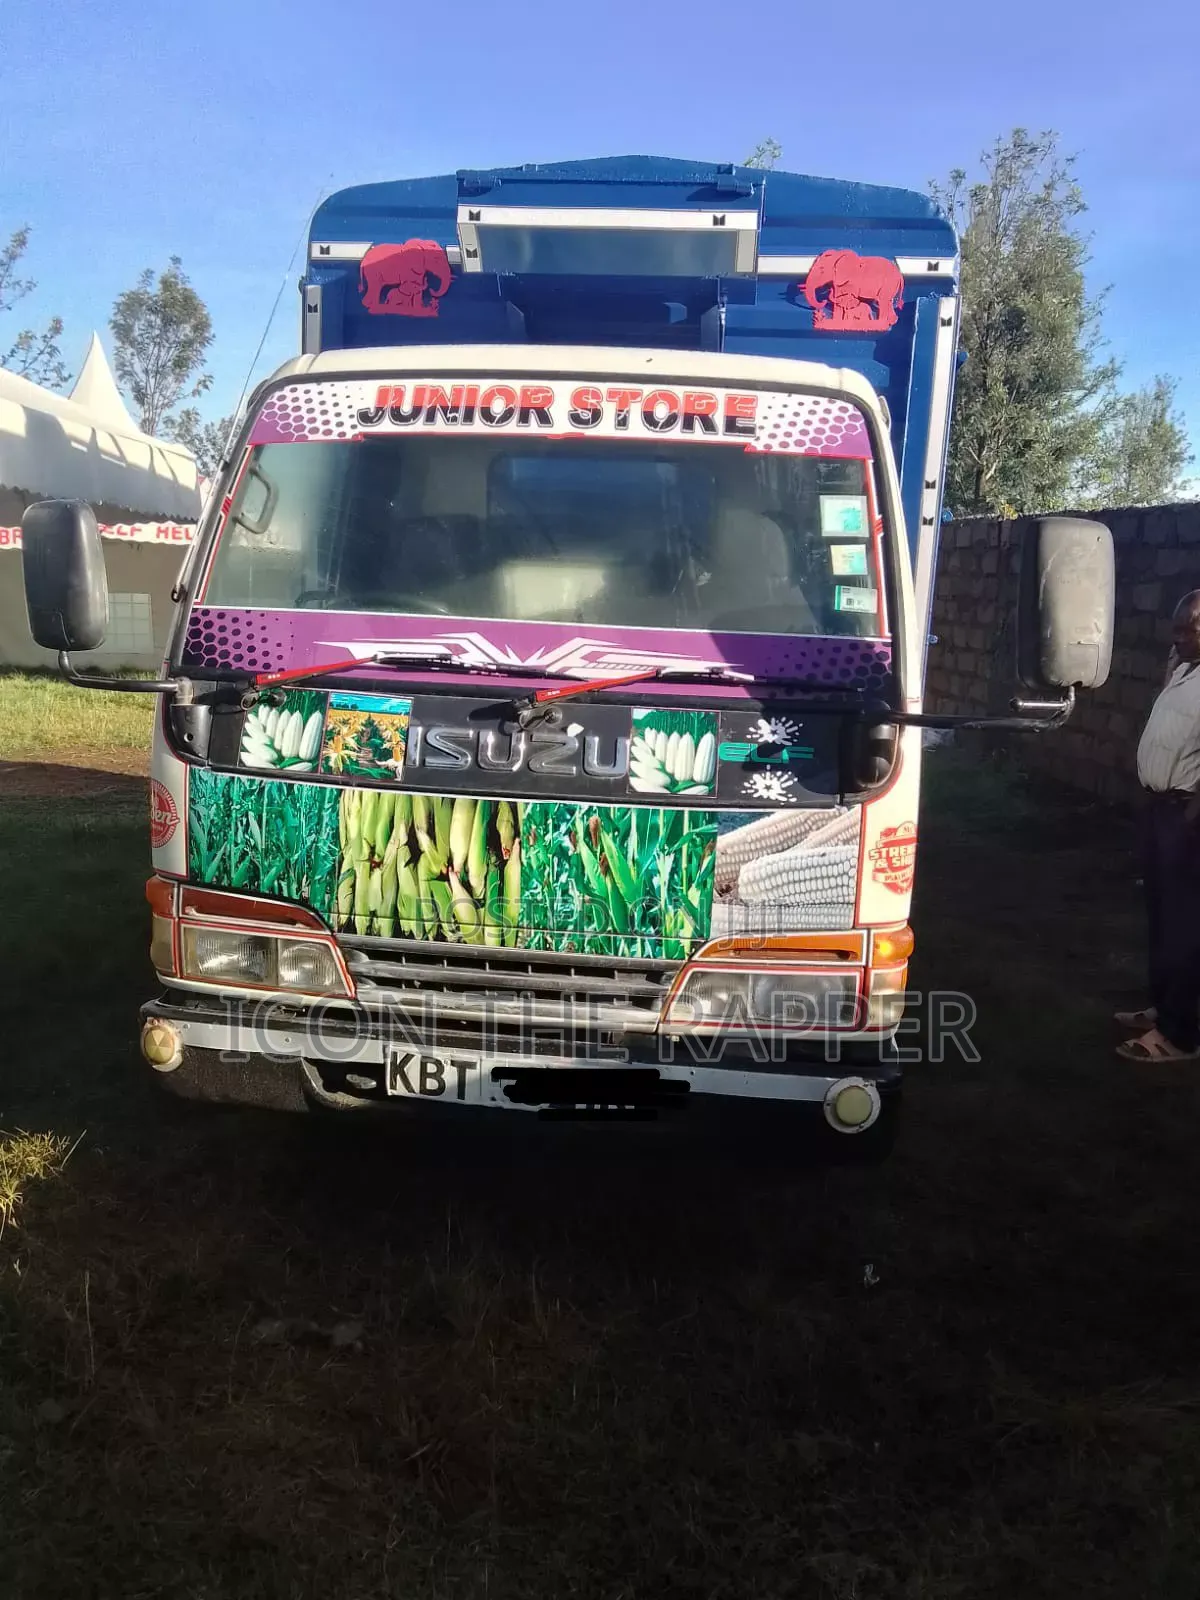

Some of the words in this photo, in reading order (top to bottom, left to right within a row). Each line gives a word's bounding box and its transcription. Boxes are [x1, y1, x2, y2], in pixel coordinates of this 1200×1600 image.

[357, 384, 555, 427] JUNIOR
[568, 386, 758, 437] STORE
[407, 726, 629, 778] ISUZU
[389, 1050, 479, 1101] KBT
